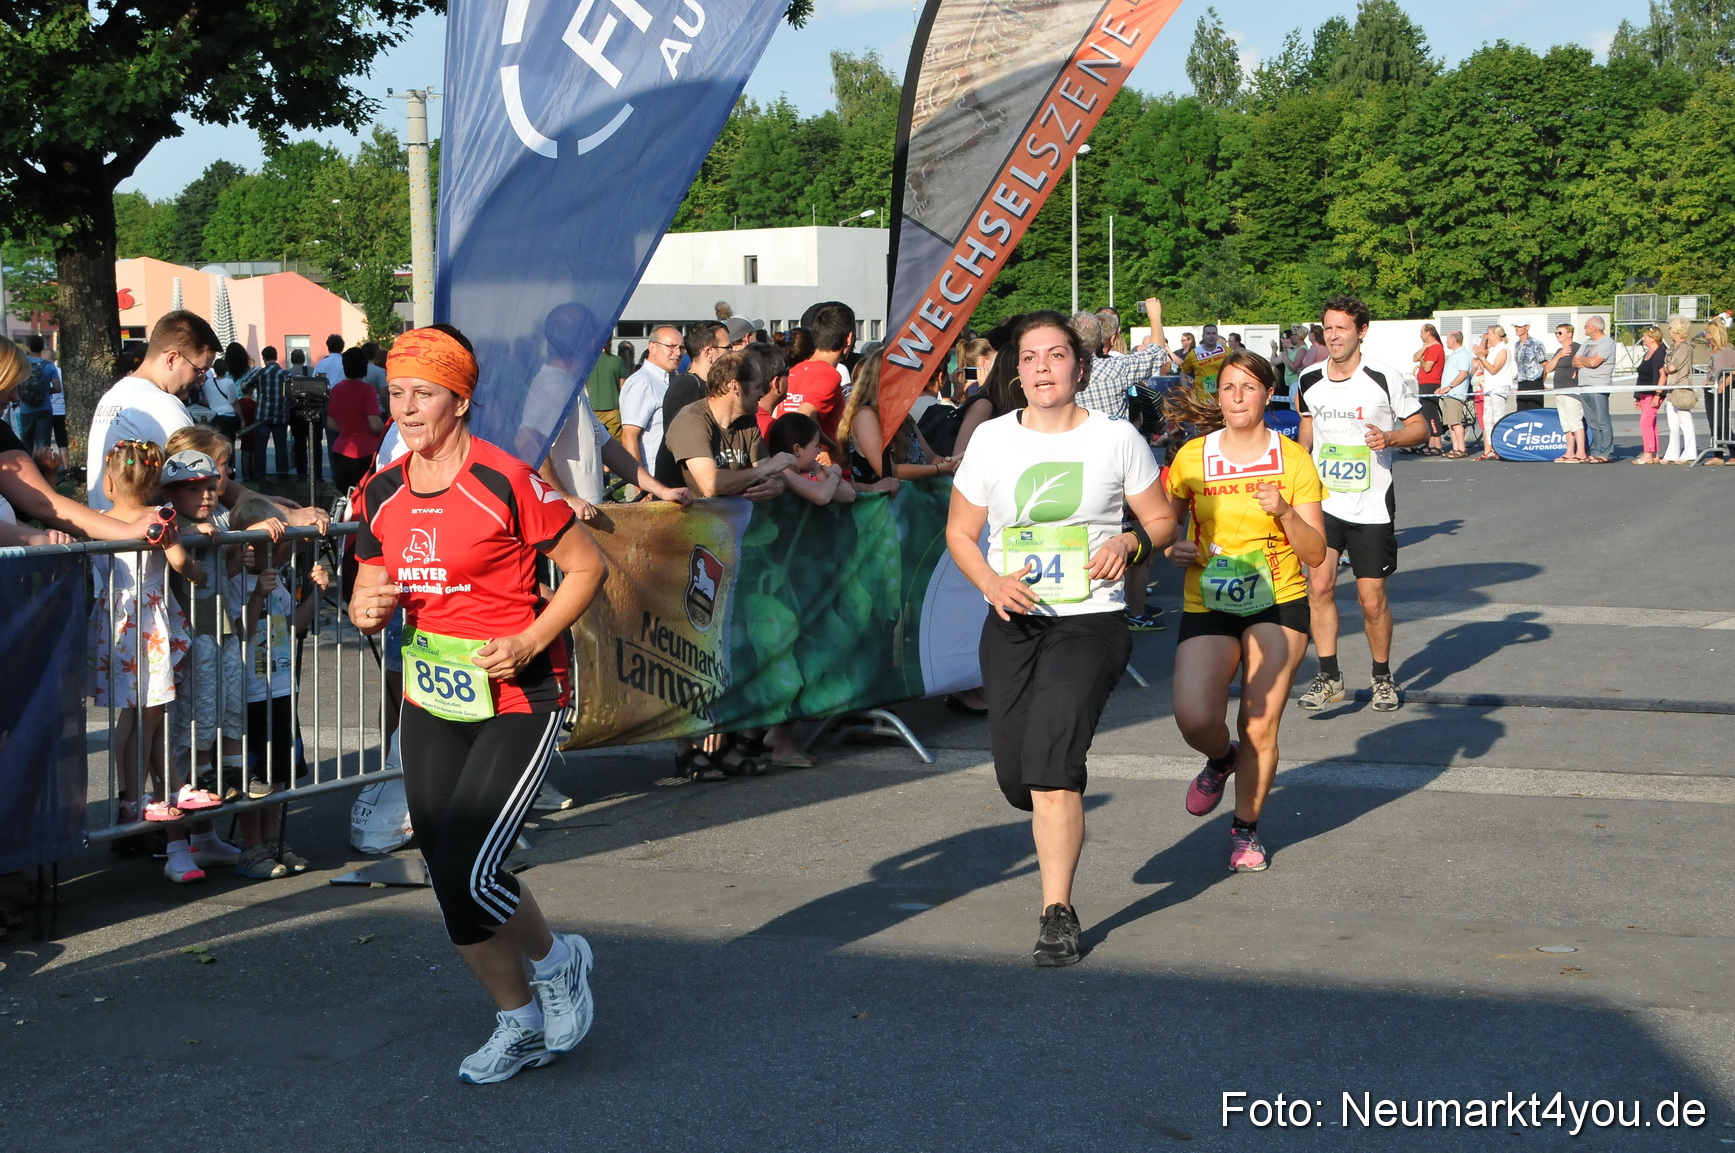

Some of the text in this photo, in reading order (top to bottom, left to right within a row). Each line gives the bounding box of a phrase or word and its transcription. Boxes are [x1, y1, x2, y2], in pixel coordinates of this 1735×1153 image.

[1313, 405, 1364, 421] Xplus1
[1516, 431, 1568, 445] Fische
[1319, 460, 1367, 480] 1429
[1203, 484, 1240, 496] MAX
[397, 567, 447, 581] MEYER
[1024, 554, 1064, 584] 94
[445, 583, 471, 594] GmbH
[1210, 574, 1260, 602] 767
[415, 660, 476, 703] 858
